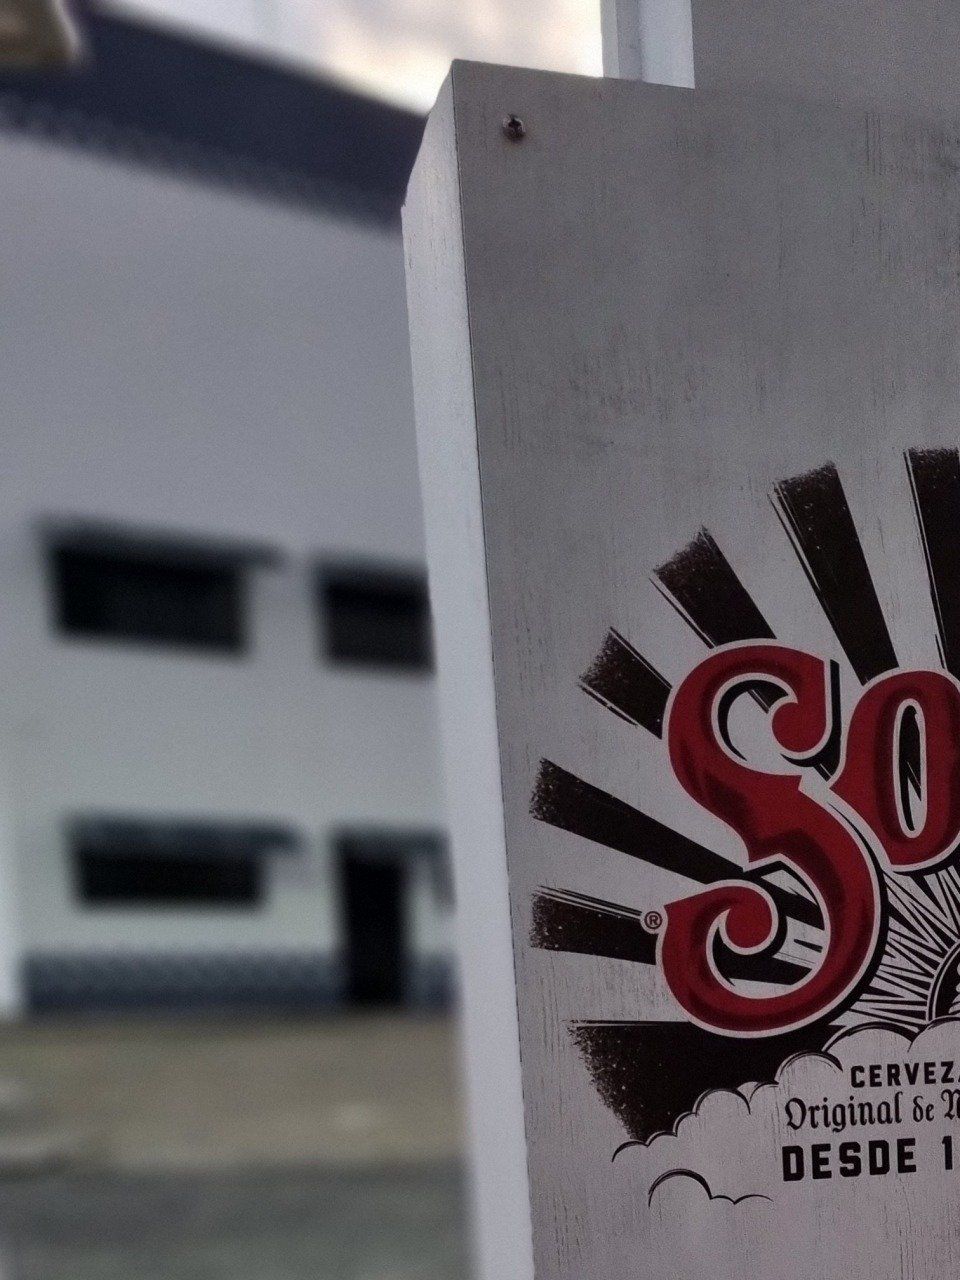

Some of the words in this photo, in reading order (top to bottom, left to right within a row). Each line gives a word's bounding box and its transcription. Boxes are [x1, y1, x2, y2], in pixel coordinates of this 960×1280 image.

[784, 1090, 904, 1133] Original
[911, 1095, 935, 1123] de
[781, 1137, 917, 1182] DESDE
